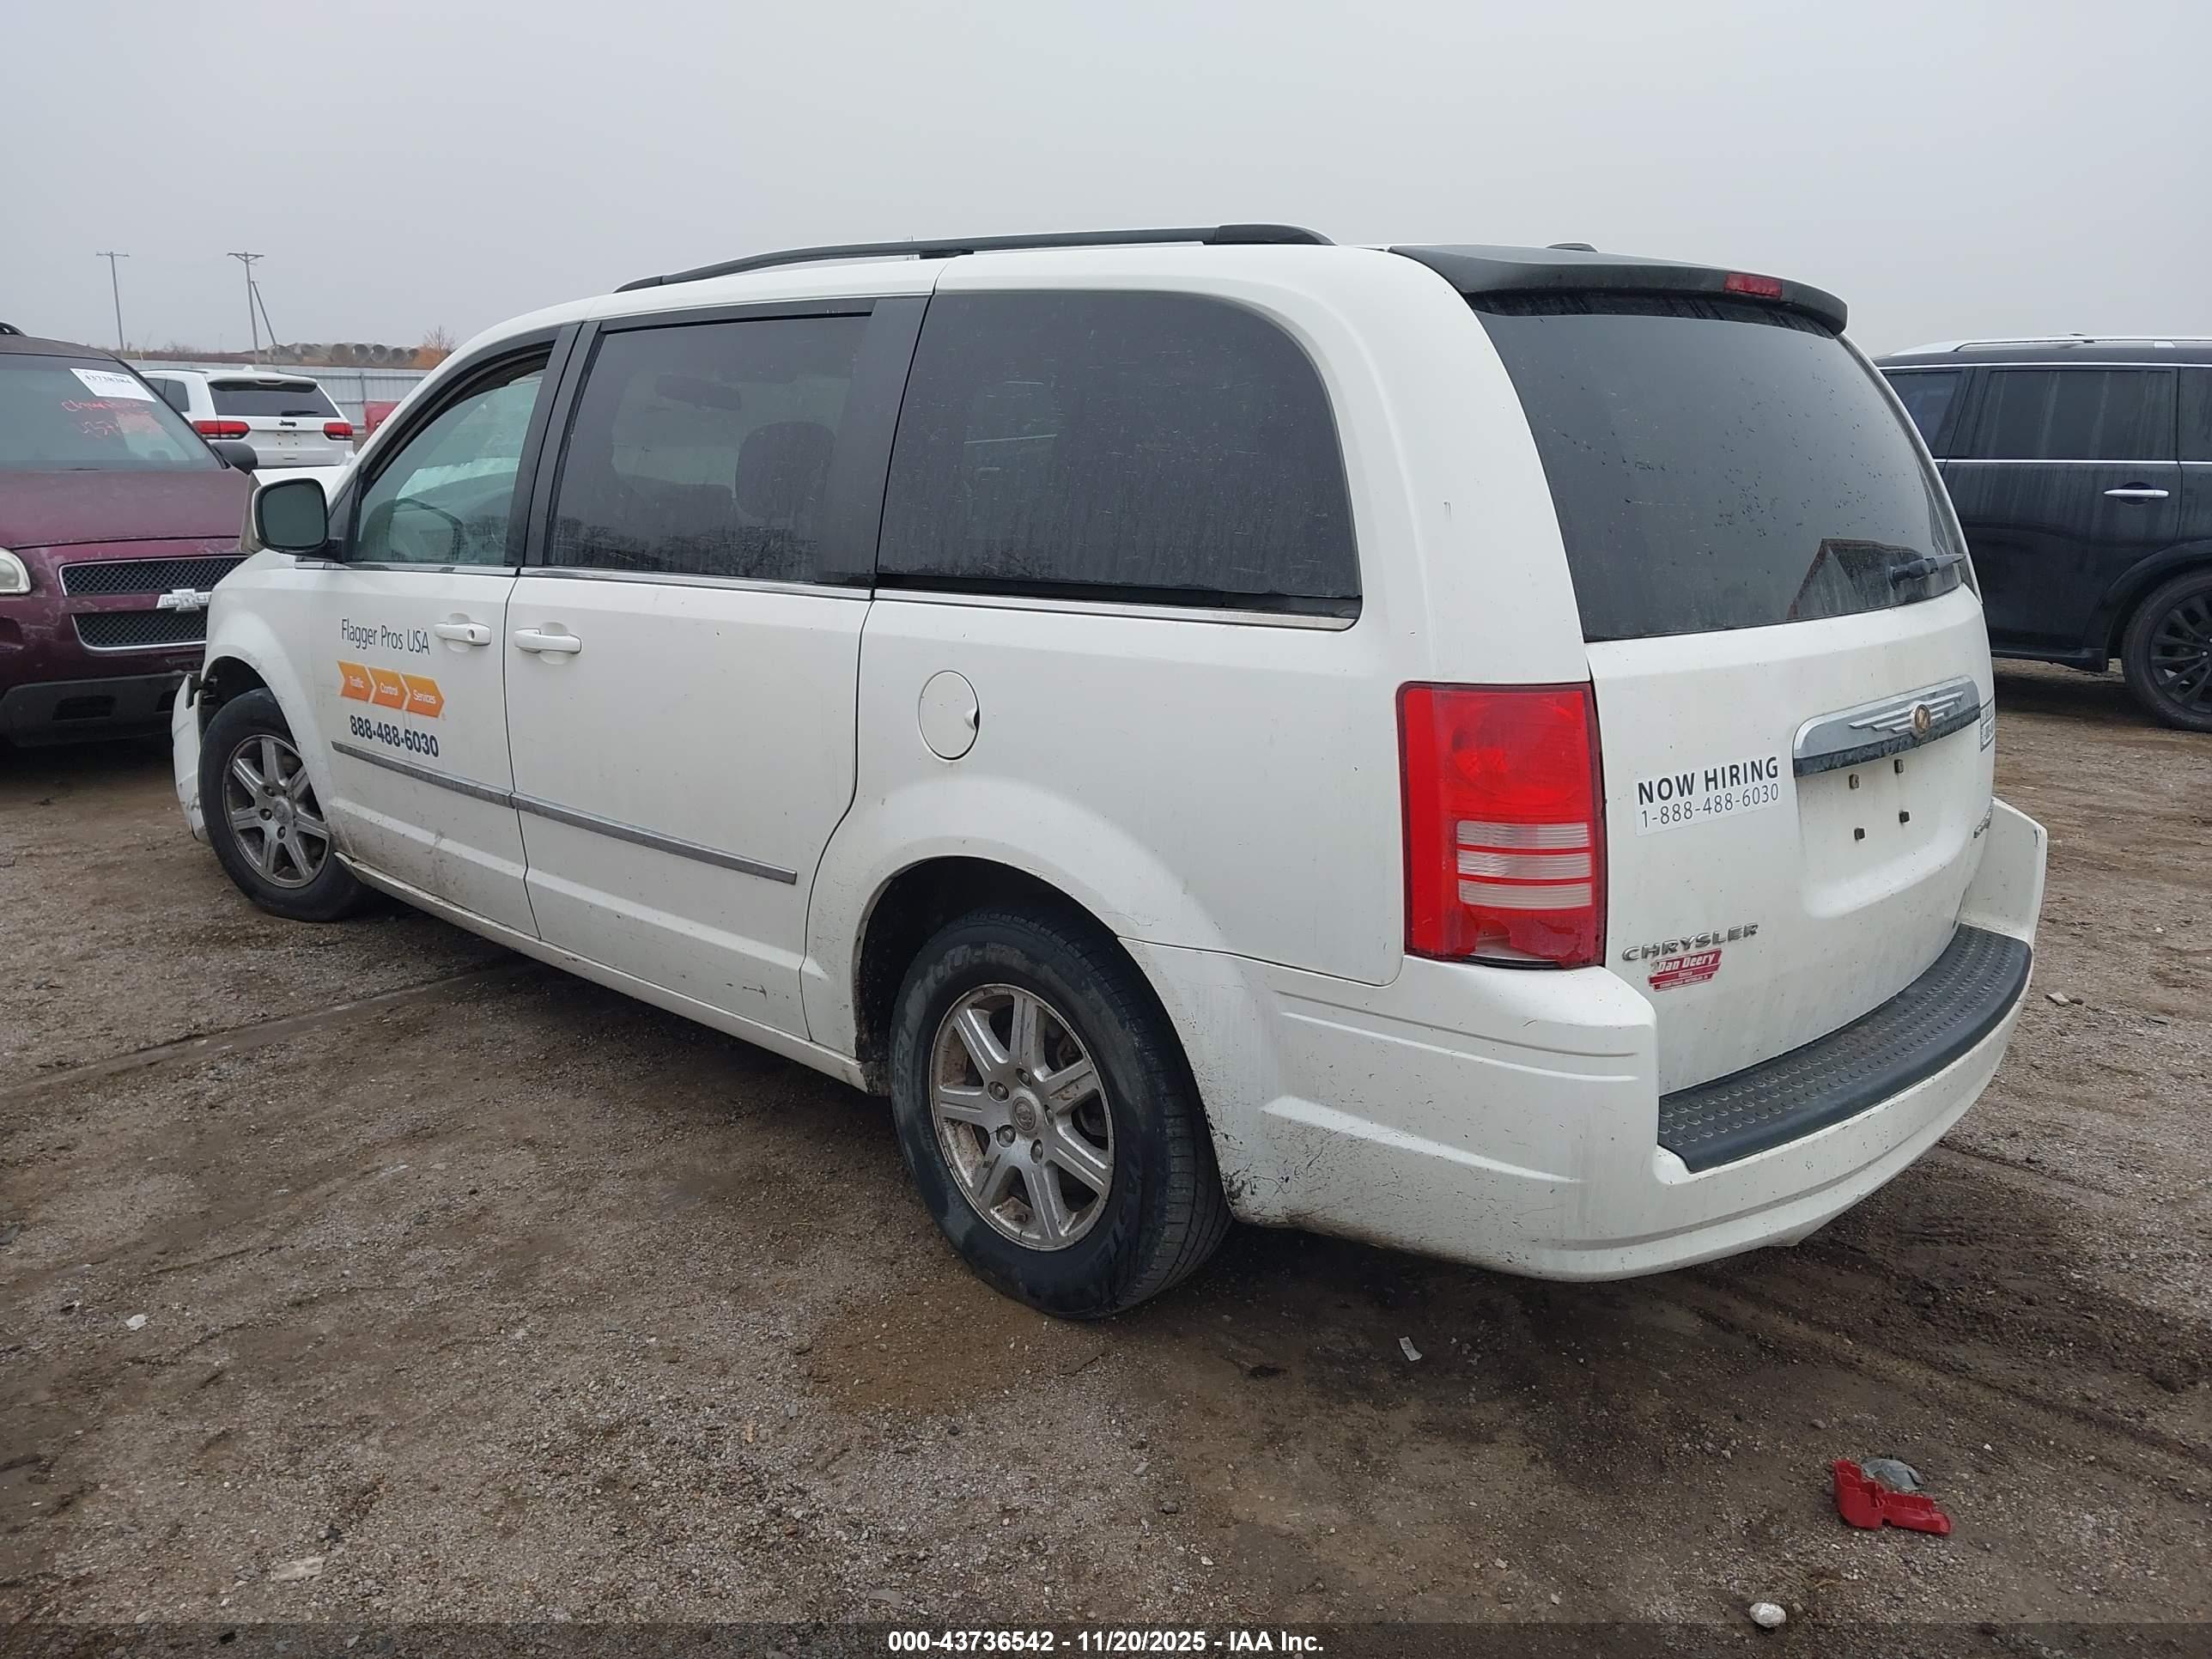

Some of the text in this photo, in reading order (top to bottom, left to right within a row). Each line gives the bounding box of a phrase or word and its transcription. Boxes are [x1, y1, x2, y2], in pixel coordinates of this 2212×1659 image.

[341, 618, 431, 655] Flagger Pros USA
[380, 682, 399, 696] Control
[412, 689, 437, 704] Services
[350, 714, 439, 757] 888-488-6030
[1638, 756, 1779, 805] NOW HIRING
[1641, 782, 1779, 829] 1-888-488-6030
[1622, 921, 1759, 963] CHRYSLER
[1657, 952, 1716, 973] Dan Deery
